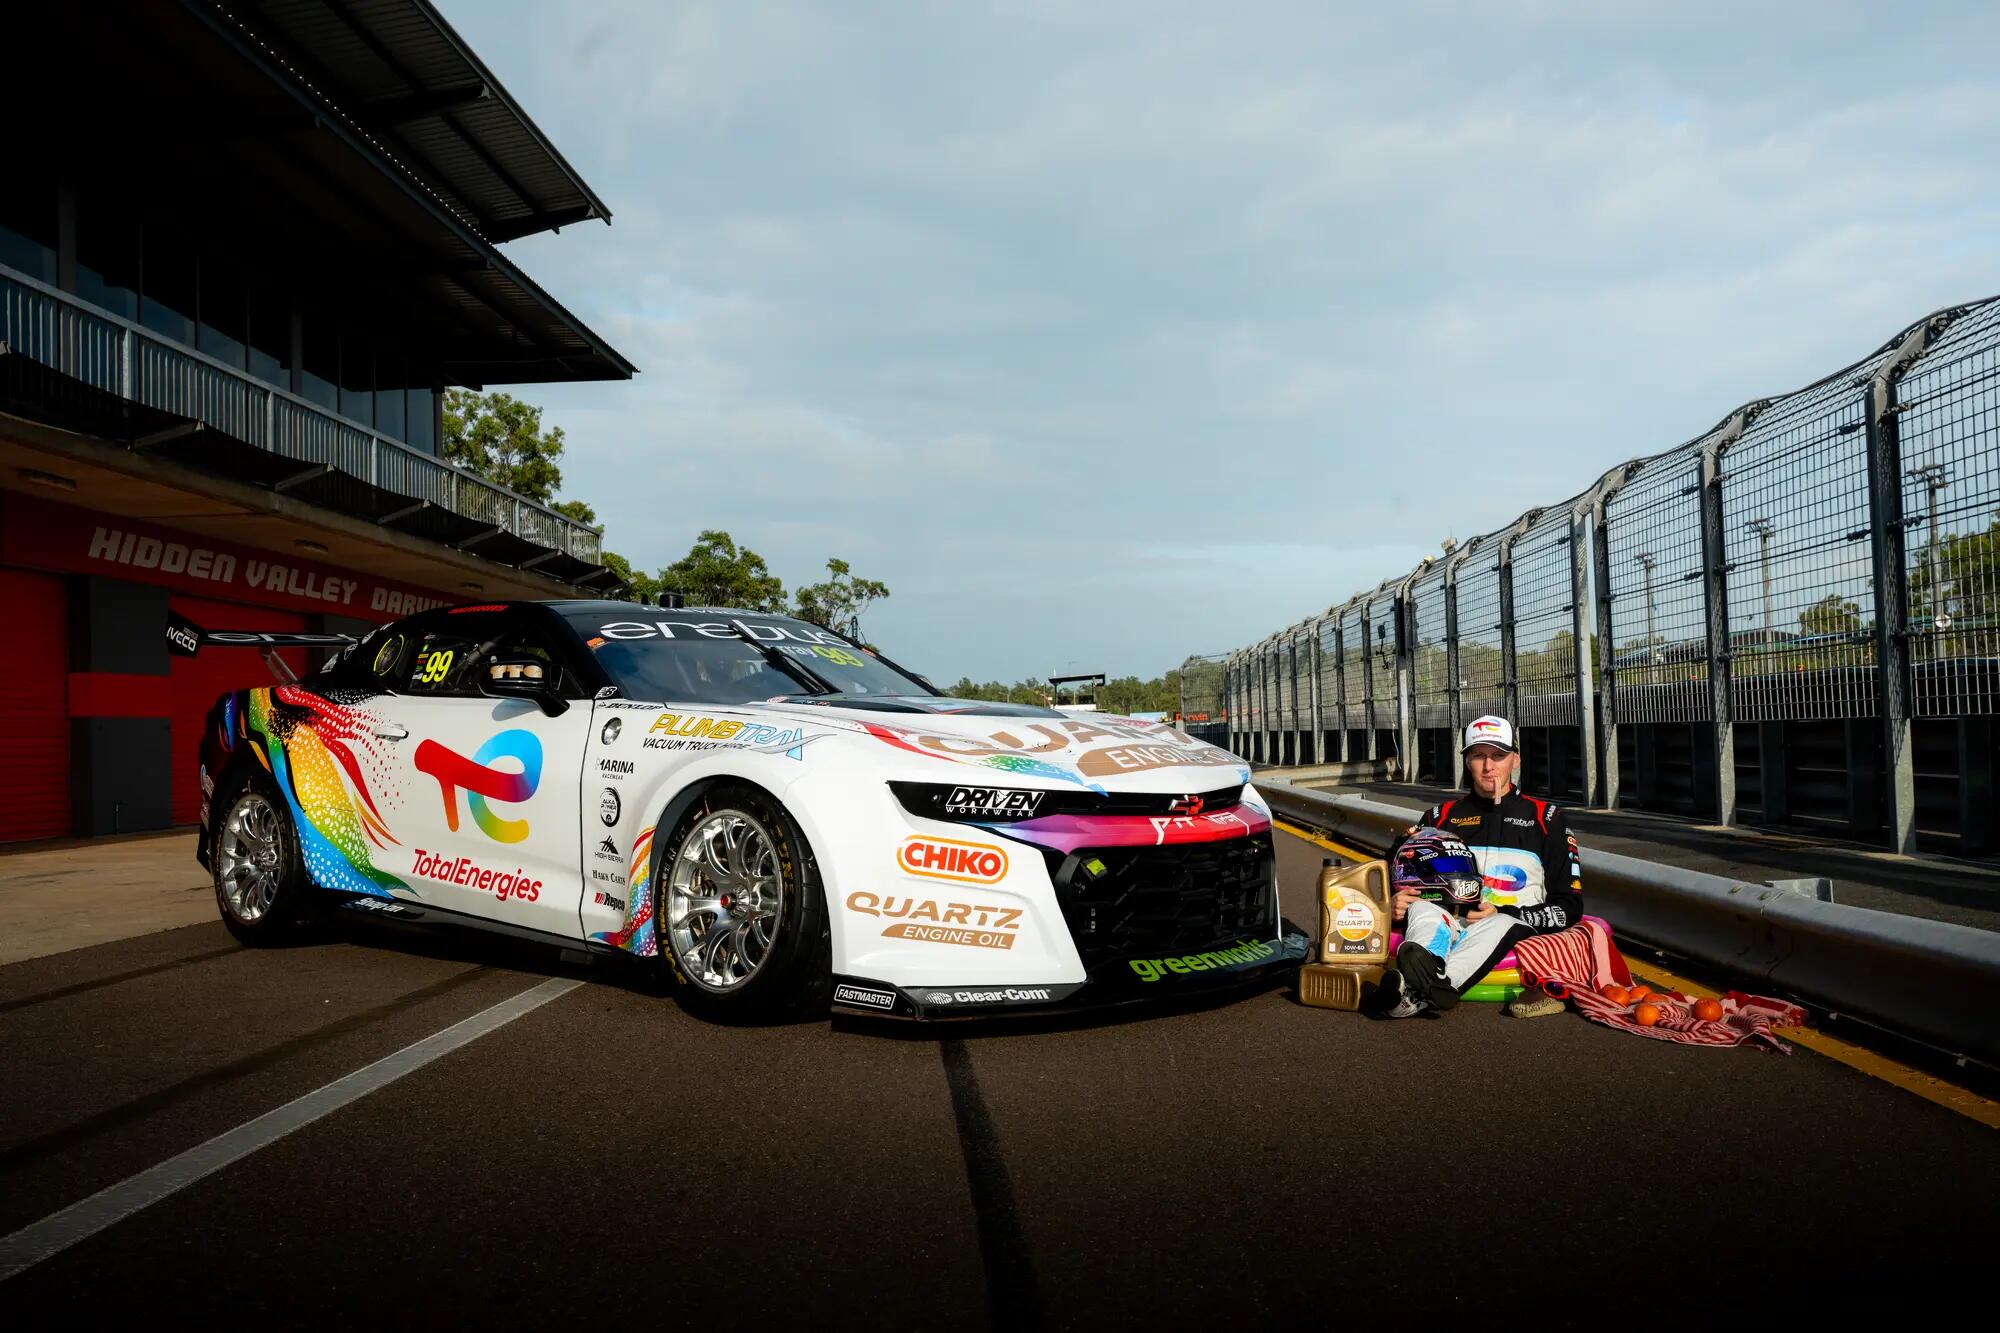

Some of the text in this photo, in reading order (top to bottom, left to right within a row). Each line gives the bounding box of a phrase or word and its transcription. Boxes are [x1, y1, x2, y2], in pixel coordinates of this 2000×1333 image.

[87, 526, 237, 584] HIDDEN
[245, 558, 358, 606] VALLEY
[166, 626, 197, 652] IVECO
[600, 618, 853, 648] erebus
[421, 650, 454, 684] 99
[811, 643, 865, 668] 99
[1175, 712, 1209, 722] Drwin
[642, 737, 686, 750] VACUUM
[685, 740, 719, 751] TRUCK
[600, 803, 617, 811] PWER
[948, 788, 1043, 811] DRIVEN
[945, 806, 1035, 818] WORKWEAR
[904, 842, 1001, 877] CHIKO
[1444, 849, 1473, 858] TRICO
[412, 848, 543, 902] TotalEnergies
[846, 891, 1024, 930] QUARTZ
[902, 925, 1009, 948] ENGINE OIL
[1129, 938, 1275, 983] greenworks
[837, 988, 892, 1006] FASTMASTER
[954, 988, 1049, 1003] Clear-Com
